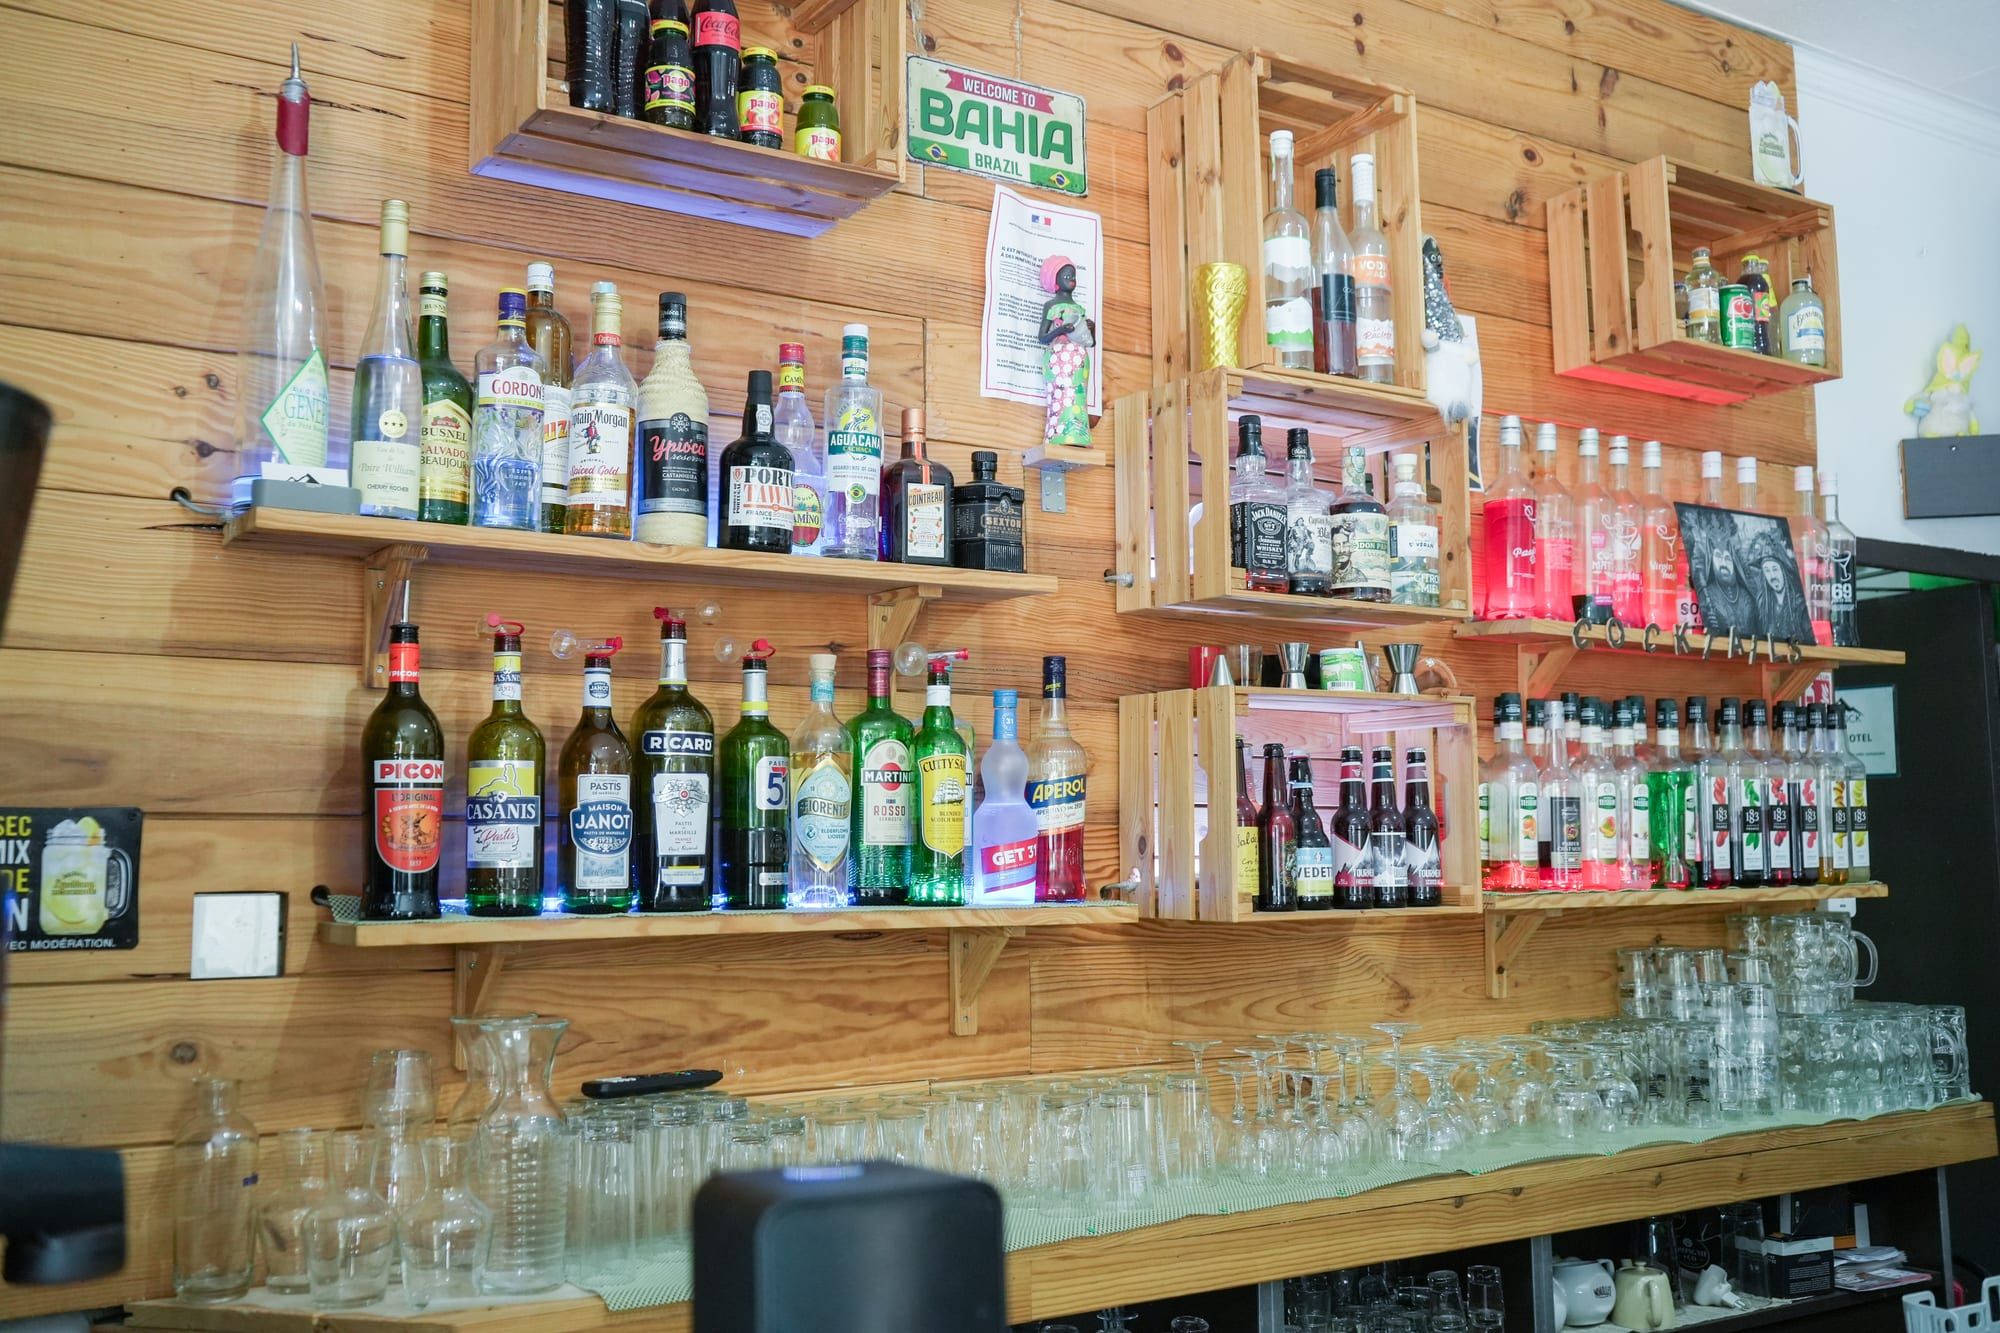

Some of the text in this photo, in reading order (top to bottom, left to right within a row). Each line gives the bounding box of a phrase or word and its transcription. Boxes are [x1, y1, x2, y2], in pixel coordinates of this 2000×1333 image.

[663, 74, 689, 88] pago
[963, 77, 1035, 107] WELCOME TO
[751, 98, 777, 110] pago
[920, 87, 1073, 165] BAHIA
[811, 134, 835, 146] pago
[975, 152, 1023, 176] BRAZIL
[594, 410, 628, 428] Morgan
[421, 427, 467, 441] BUSNEL
[830, 433, 880, 449] AGUACANA
[650, 435, 706, 462] Ypióca
[570, 465, 620, 477] Spiced Gold
[744, 484, 793, 507] TAWN
[909, 491, 943, 505] COINTREAU
[1832, 583, 1852, 600] 69
[650, 736, 712, 751] RICARD
[1849, 733, 1872, 743] OTEL
[380, 763, 443, 779] PICON
[923, 758, 954, 773] CUTTY
[590, 782, 621, 790] PASTIS
[1032, 778, 1085, 803] APEROL
[467, 803, 535, 820] CASANIS
[589, 804, 622, 812] MAISON
[874, 806, 905, 816] ROSSO
[575, 813, 630, 829] JANOT
[481, 828, 514, 842] Pastis
[992, 848, 1025, 866] GET
